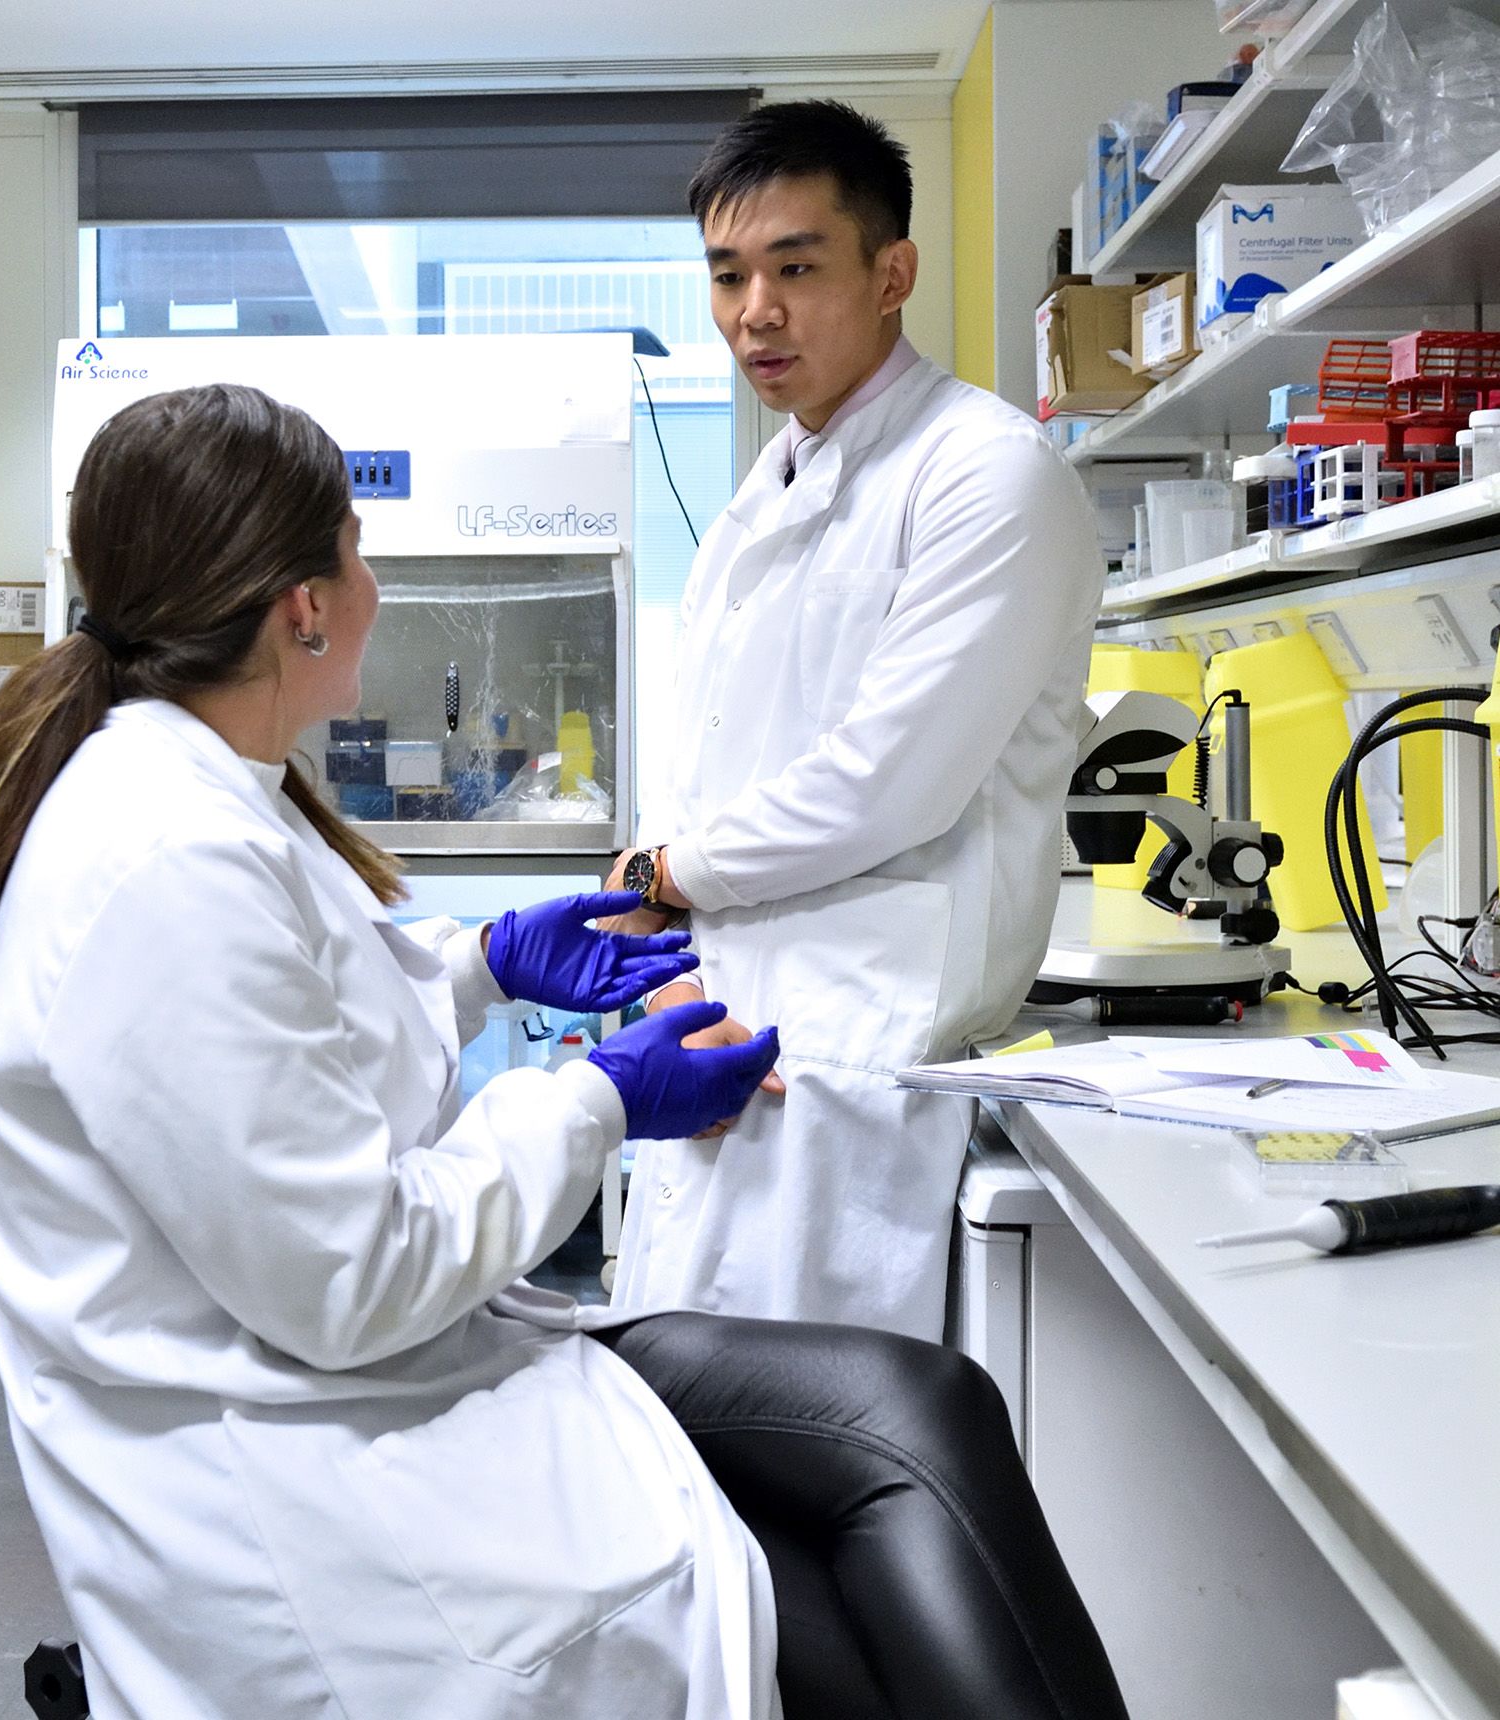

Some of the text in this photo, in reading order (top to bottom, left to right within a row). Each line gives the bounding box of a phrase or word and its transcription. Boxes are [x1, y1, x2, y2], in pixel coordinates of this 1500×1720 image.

[1239, 236, 1354, 249] Centrifugal Filter Units
[61, 366, 149, 379] Air Science
[458, 504, 618, 537] LF-Series
